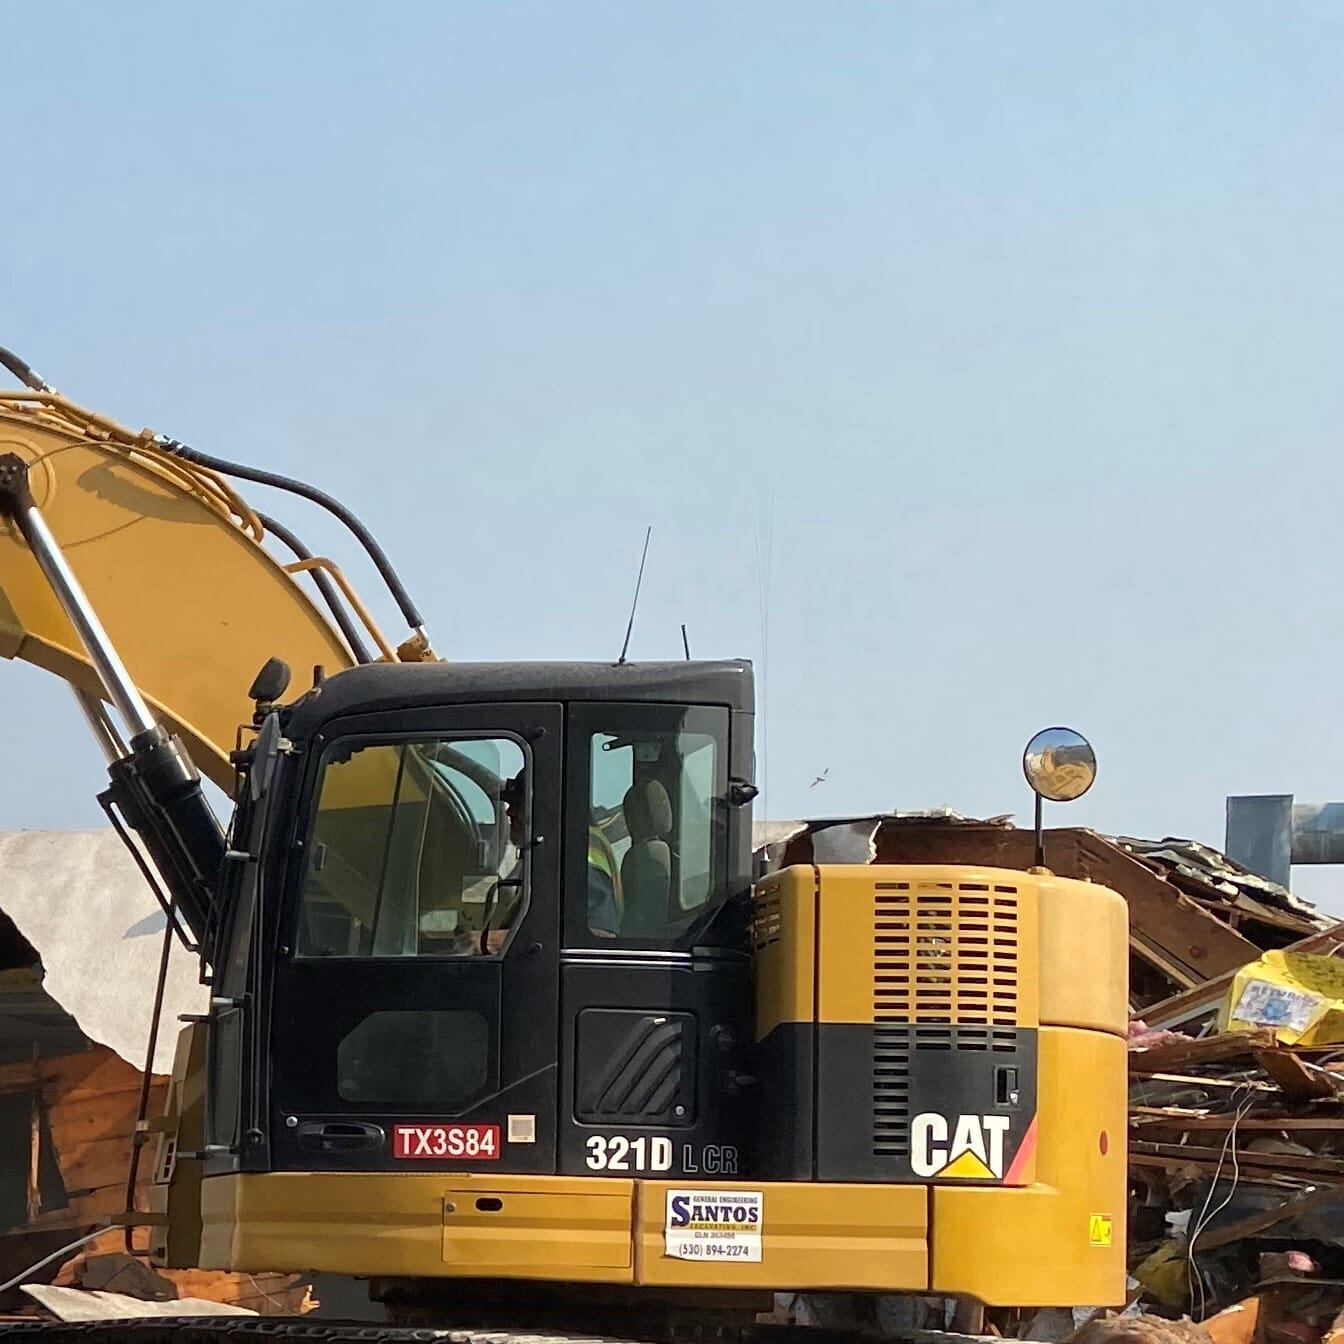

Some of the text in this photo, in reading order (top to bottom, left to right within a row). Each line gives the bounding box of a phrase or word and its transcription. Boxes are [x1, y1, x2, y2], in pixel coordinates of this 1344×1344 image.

[398, 1127, 495, 1156] TX3S84
[585, 1135, 673, 1171] 321D
[911, 1112, 1010, 1179] CAT
[671, 1196, 758, 1227] SANTOS
[693, 1195, 758, 1205] GENERAL ENGINEERING
[679, 1243, 749, 1257] (530) 894-2274
